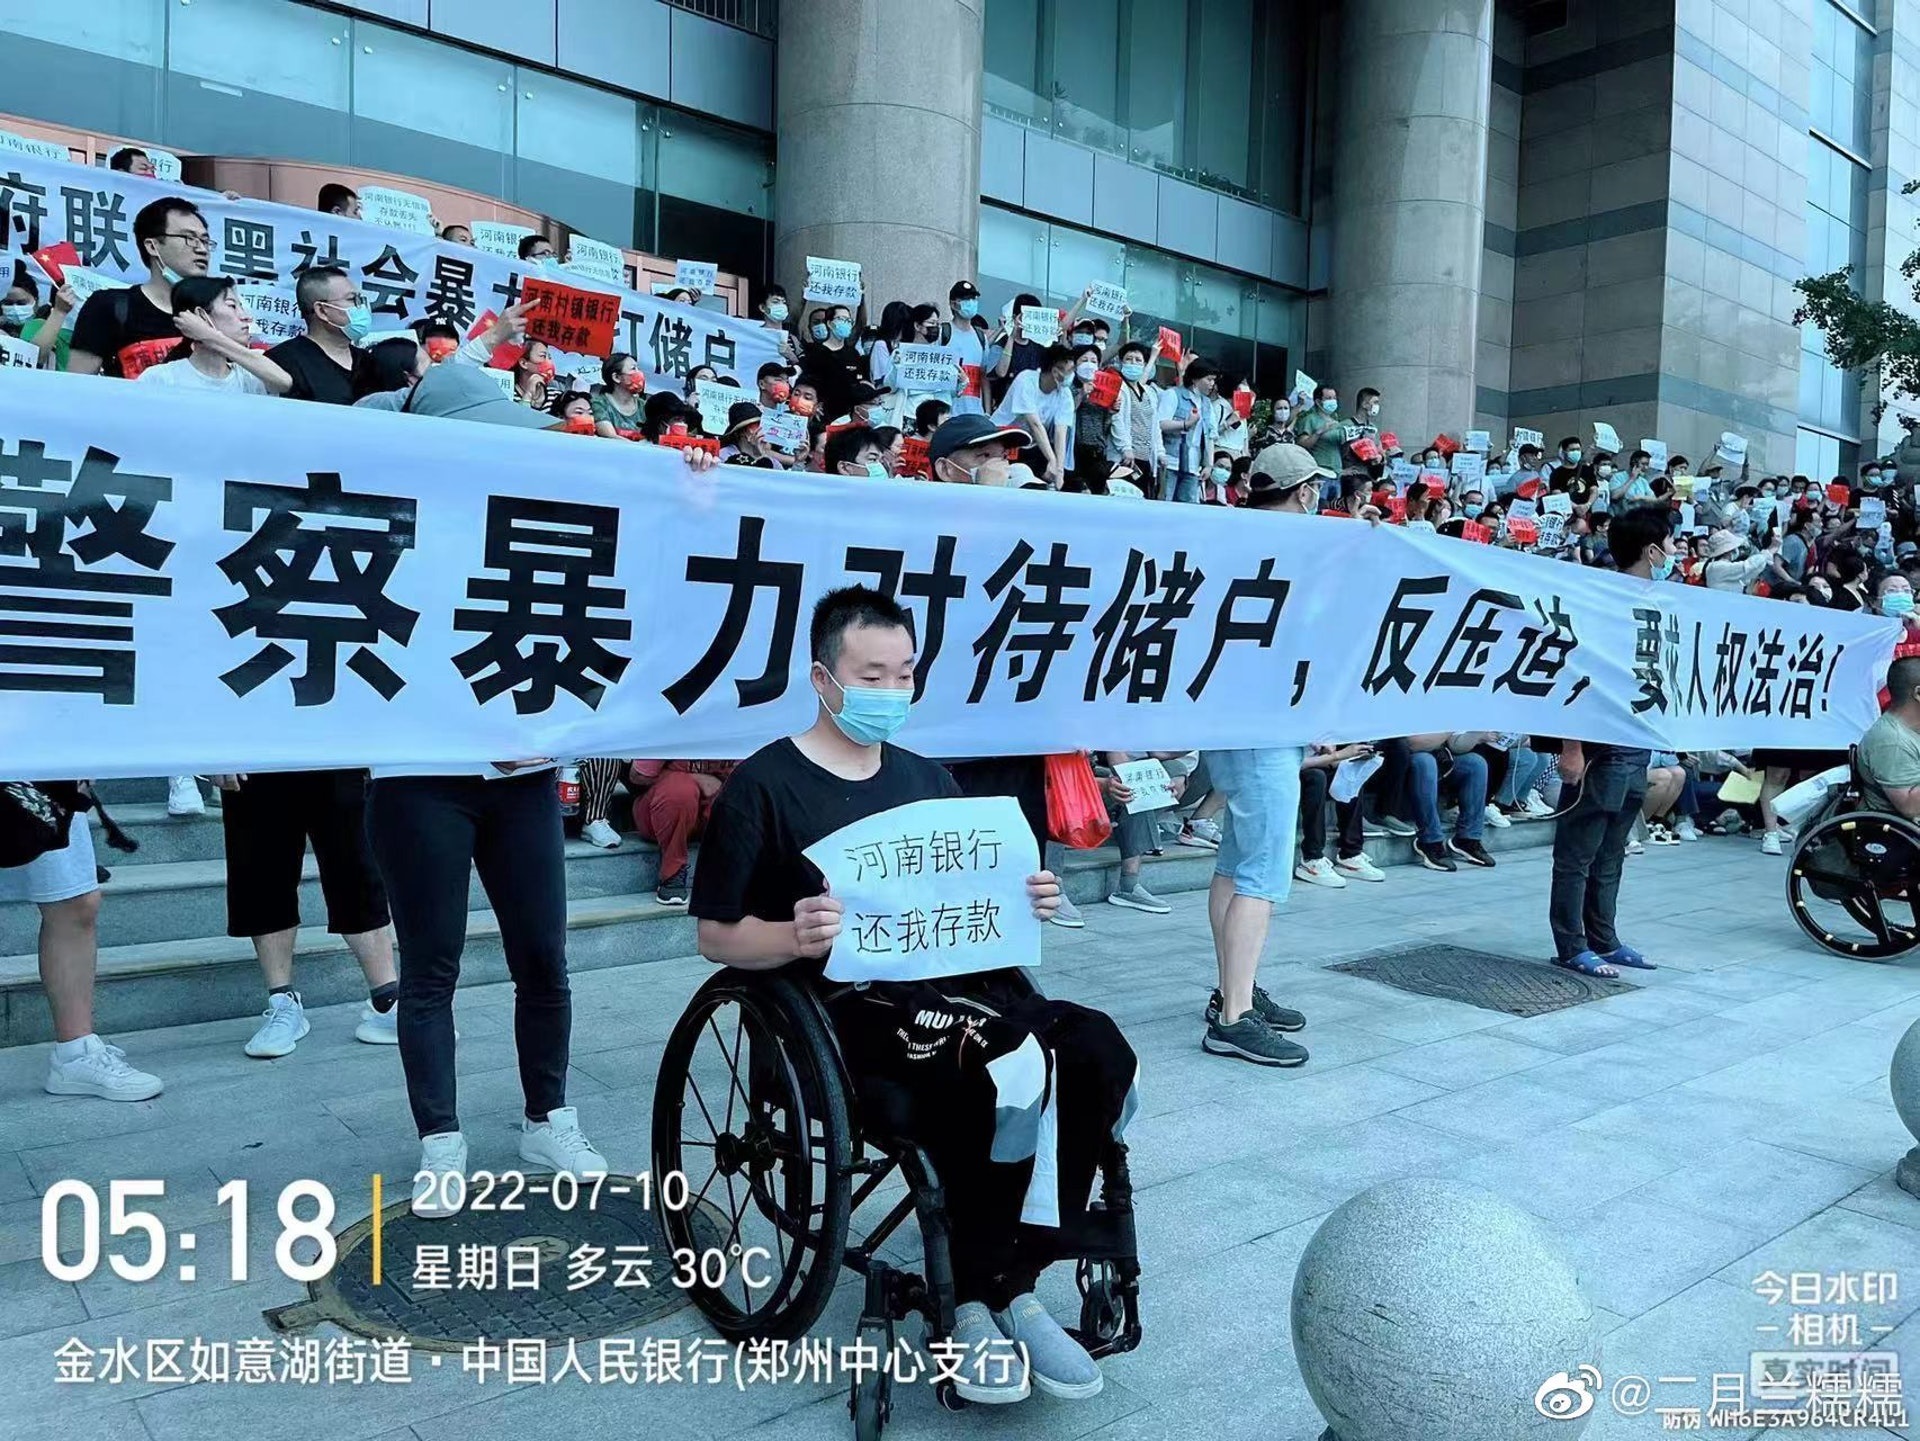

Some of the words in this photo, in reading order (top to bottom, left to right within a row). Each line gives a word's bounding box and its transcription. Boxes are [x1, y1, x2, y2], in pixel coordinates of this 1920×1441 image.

[0, 135, 60, 160] 南银行
[810, 264, 858, 283] 河南银行
[809, 281, 858, 298] 还我存款
[255, 318, 306, 338] 我存款
[904, 350, 953, 366] 河南银行
[903, 367, 952, 382] 还我存款
[843, 828, 1003, 883] 河南银行
[851, 897, 1002, 954] 还我存款
